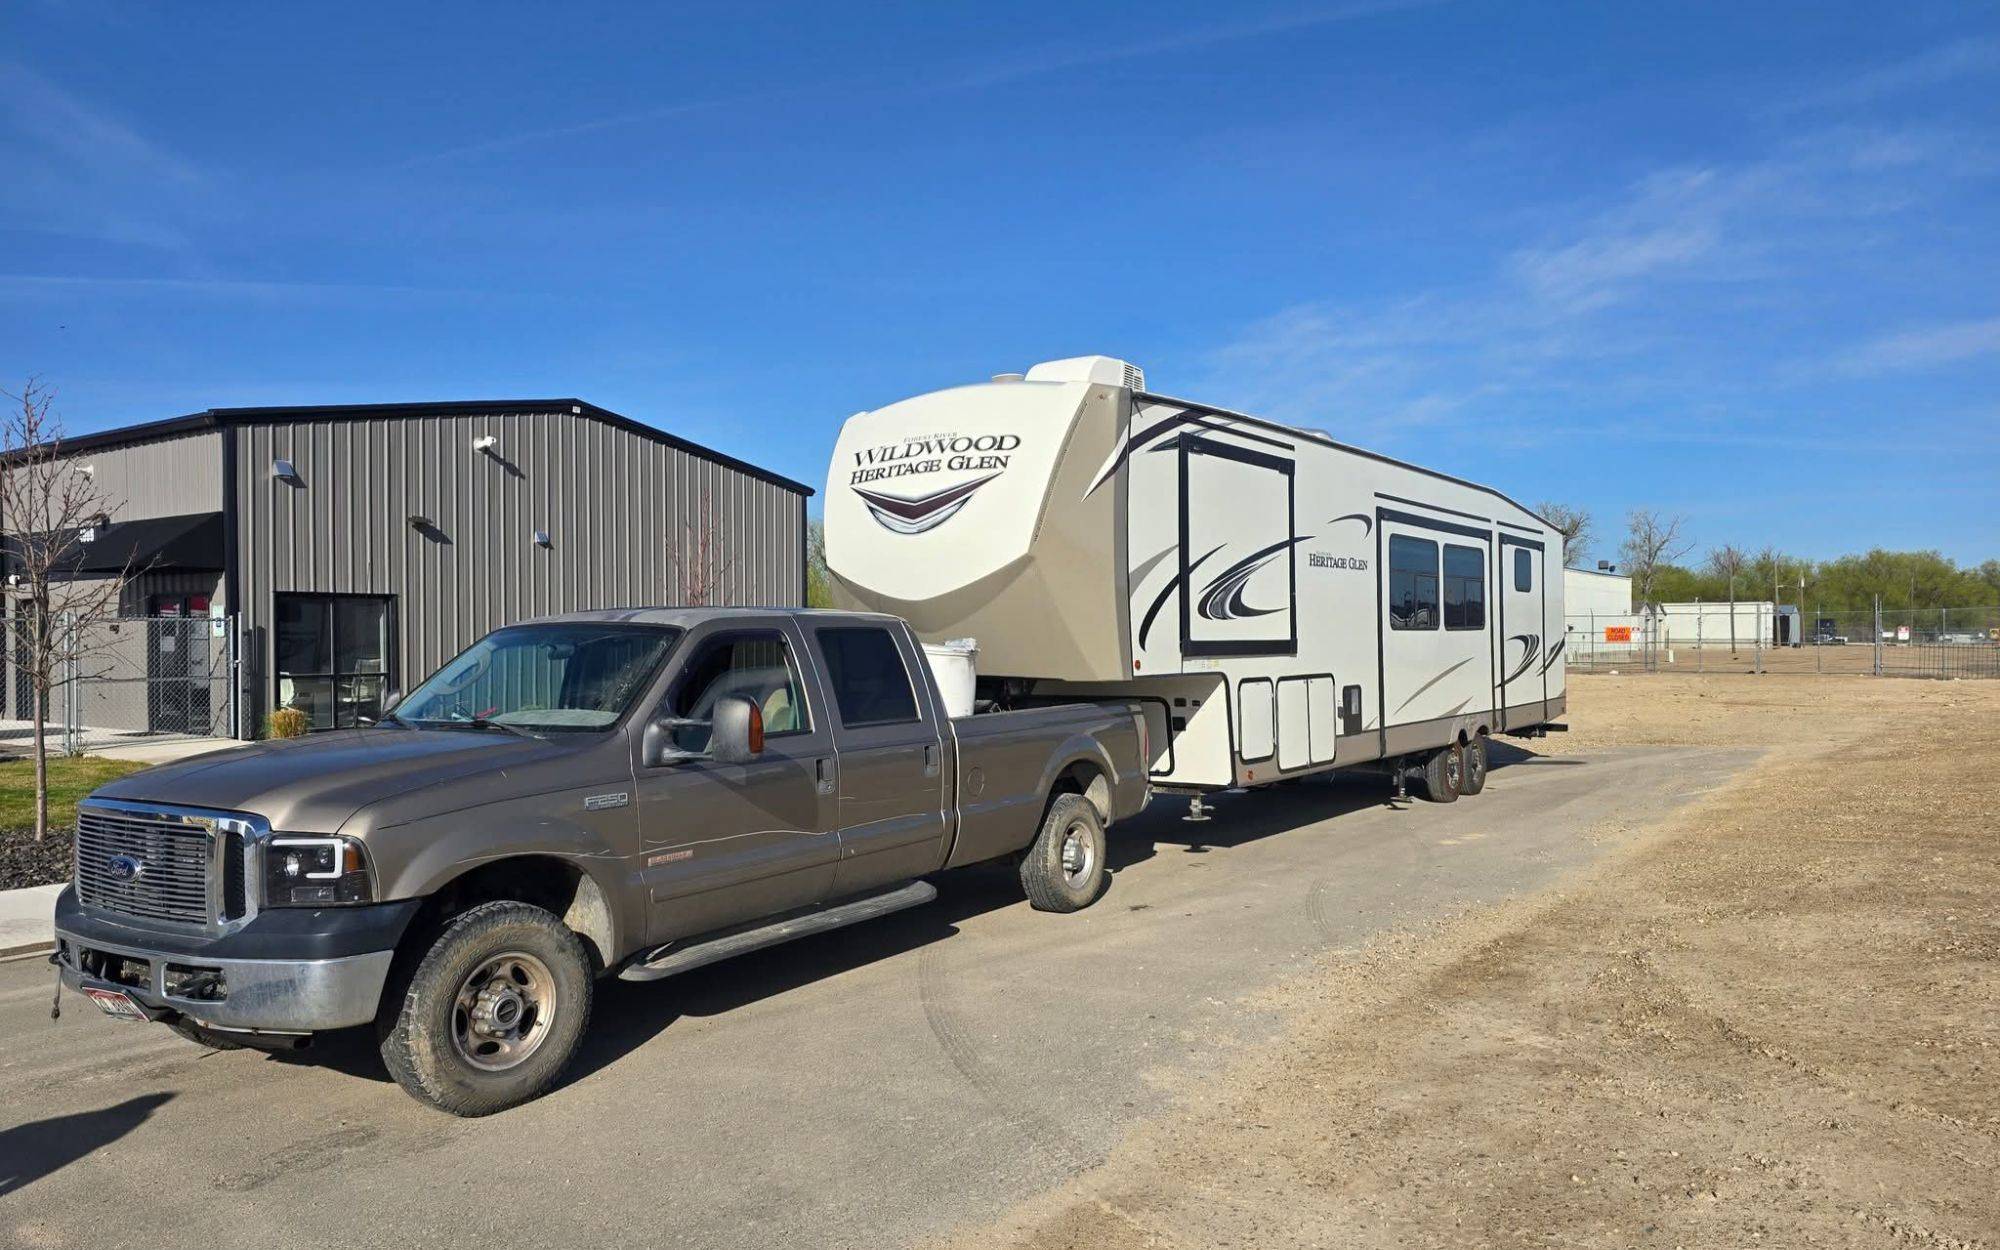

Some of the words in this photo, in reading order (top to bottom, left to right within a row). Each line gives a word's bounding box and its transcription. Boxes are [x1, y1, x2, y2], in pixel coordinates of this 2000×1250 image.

[933, 432, 958, 440] RIVER
[854, 434, 1022, 467] WILDWOOD
[850, 459, 942, 485] HERITAGE
[947, 454, 1011, 472] GLEN
[1309, 553, 1347, 569] HERITAGE
[1348, 557, 1368, 571] GLEN
[1607, 633, 1630, 641] CLOSED
[1610, 626, 1626, 634] ROAD
[110, 861, 129, 876] Ford
